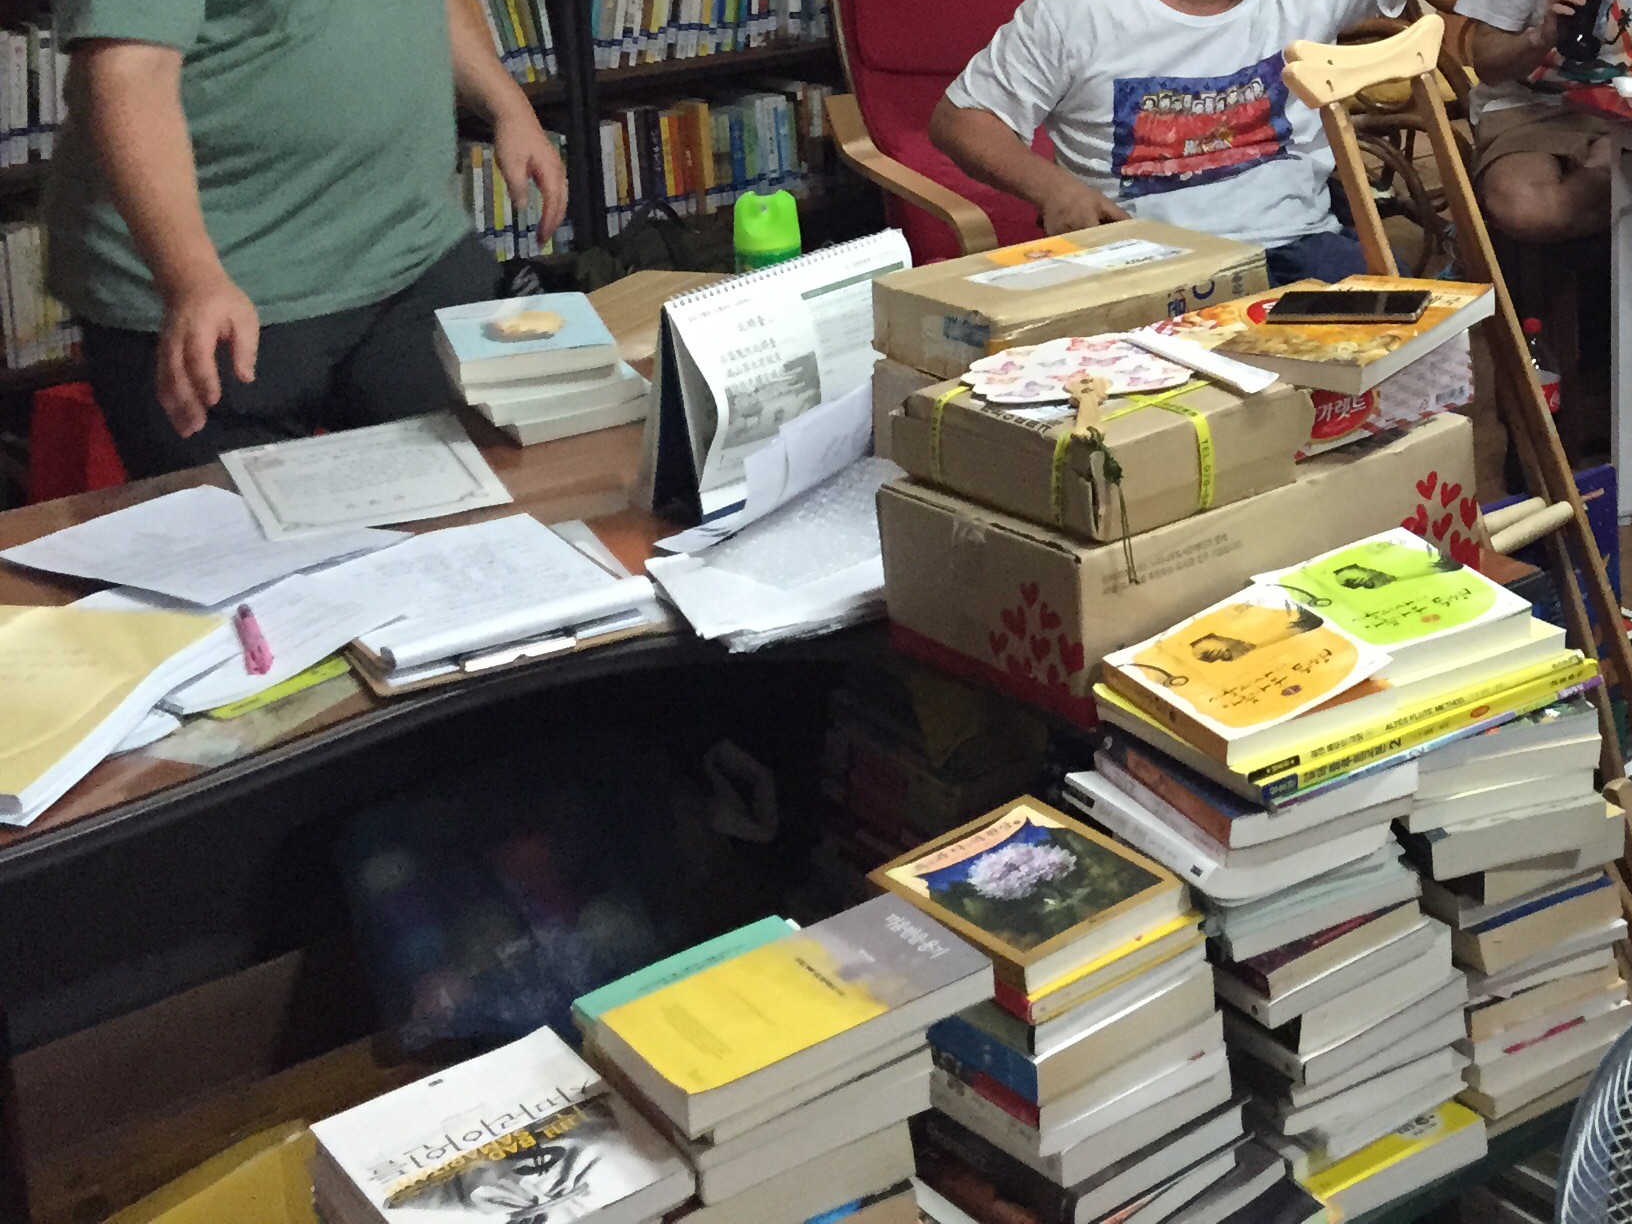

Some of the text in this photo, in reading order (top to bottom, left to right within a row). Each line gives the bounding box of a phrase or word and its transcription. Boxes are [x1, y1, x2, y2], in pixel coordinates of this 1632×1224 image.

[1313, 394, 1367, 423] 가렛트
[367, 1080, 589, 1186] 사마리아인들
[488, 1134, 537, 1162] BAD
